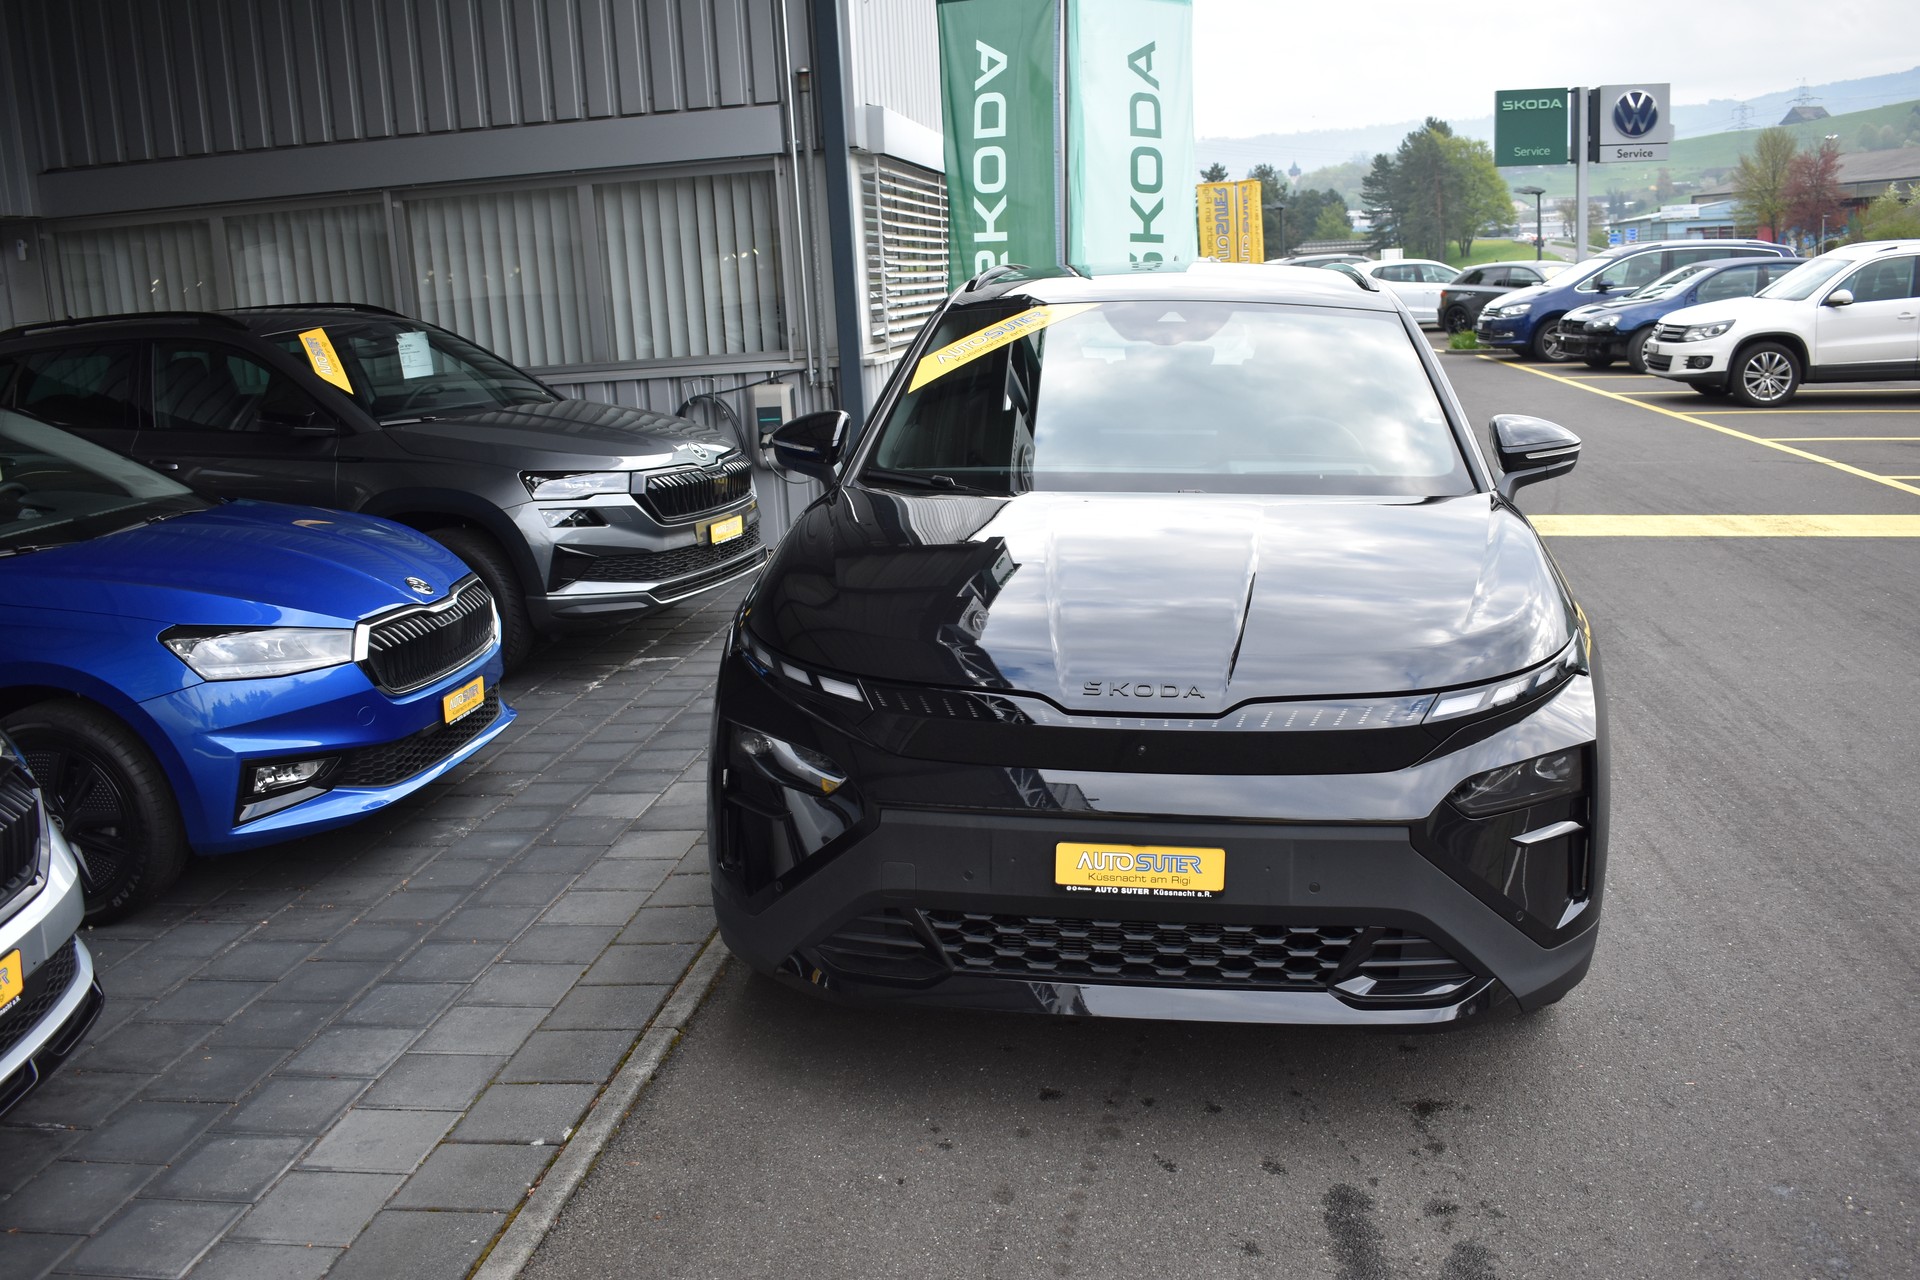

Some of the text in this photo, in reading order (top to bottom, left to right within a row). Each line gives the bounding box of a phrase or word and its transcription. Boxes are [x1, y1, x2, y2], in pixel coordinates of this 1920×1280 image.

[1514, 146, 1551, 157] Service
[1617, 148, 1654, 159] Service
[1088, 872, 1147, 884] Küssnacht
[1171, 876, 1191, 887] Rigi
[1095, 886, 1119, 894] AUTO
[1121, 887, 1150, 895] SUTER
[1153, 888, 1196, 897] Küssnacht
